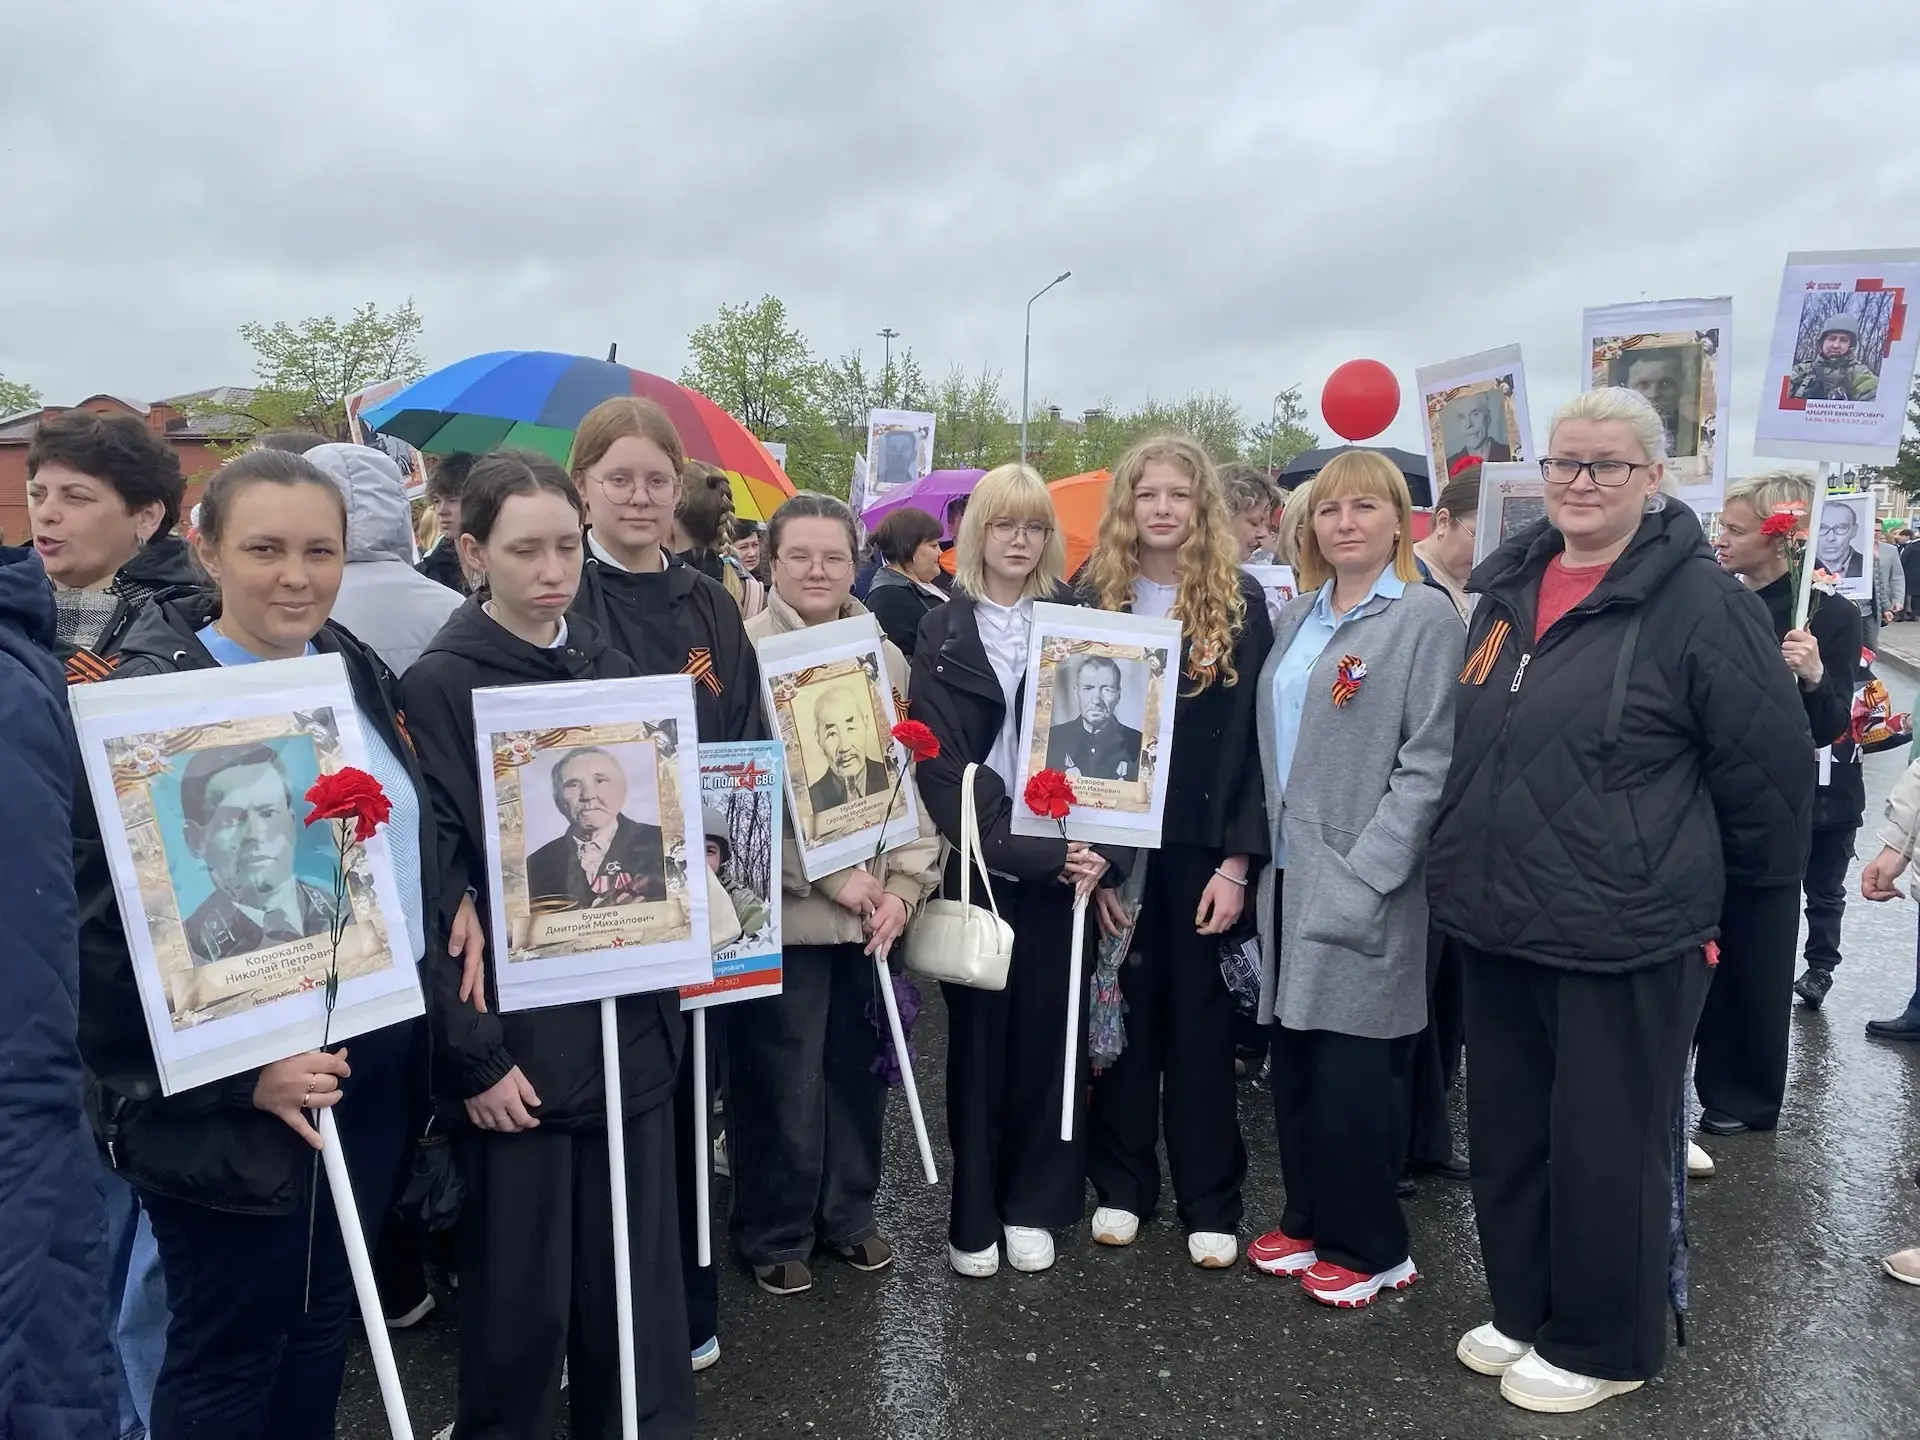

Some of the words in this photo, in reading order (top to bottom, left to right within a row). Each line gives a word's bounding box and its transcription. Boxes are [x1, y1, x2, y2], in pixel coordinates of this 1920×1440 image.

[714, 776, 741, 788] ПОЛК
[755, 774, 775, 786] СВО
[1076, 777, 1105, 786] Суворов
[1087, 785, 1121, 794] Иванович
[840, 800, 868, 813] Мусабаев
[581, 910, 619, 921] Бушуев
[545, 922, 591, 936] Дмитрий
[593, 915, 655, 929] Михайлович
[245, 942, 314, 966] Корюкалов
[715, 950, 737, 961] КИЙ
[225, 962, 279, 985] Николай
[263, 972, 282, 982] 1915
[287, 965, 306, 975] 1943
